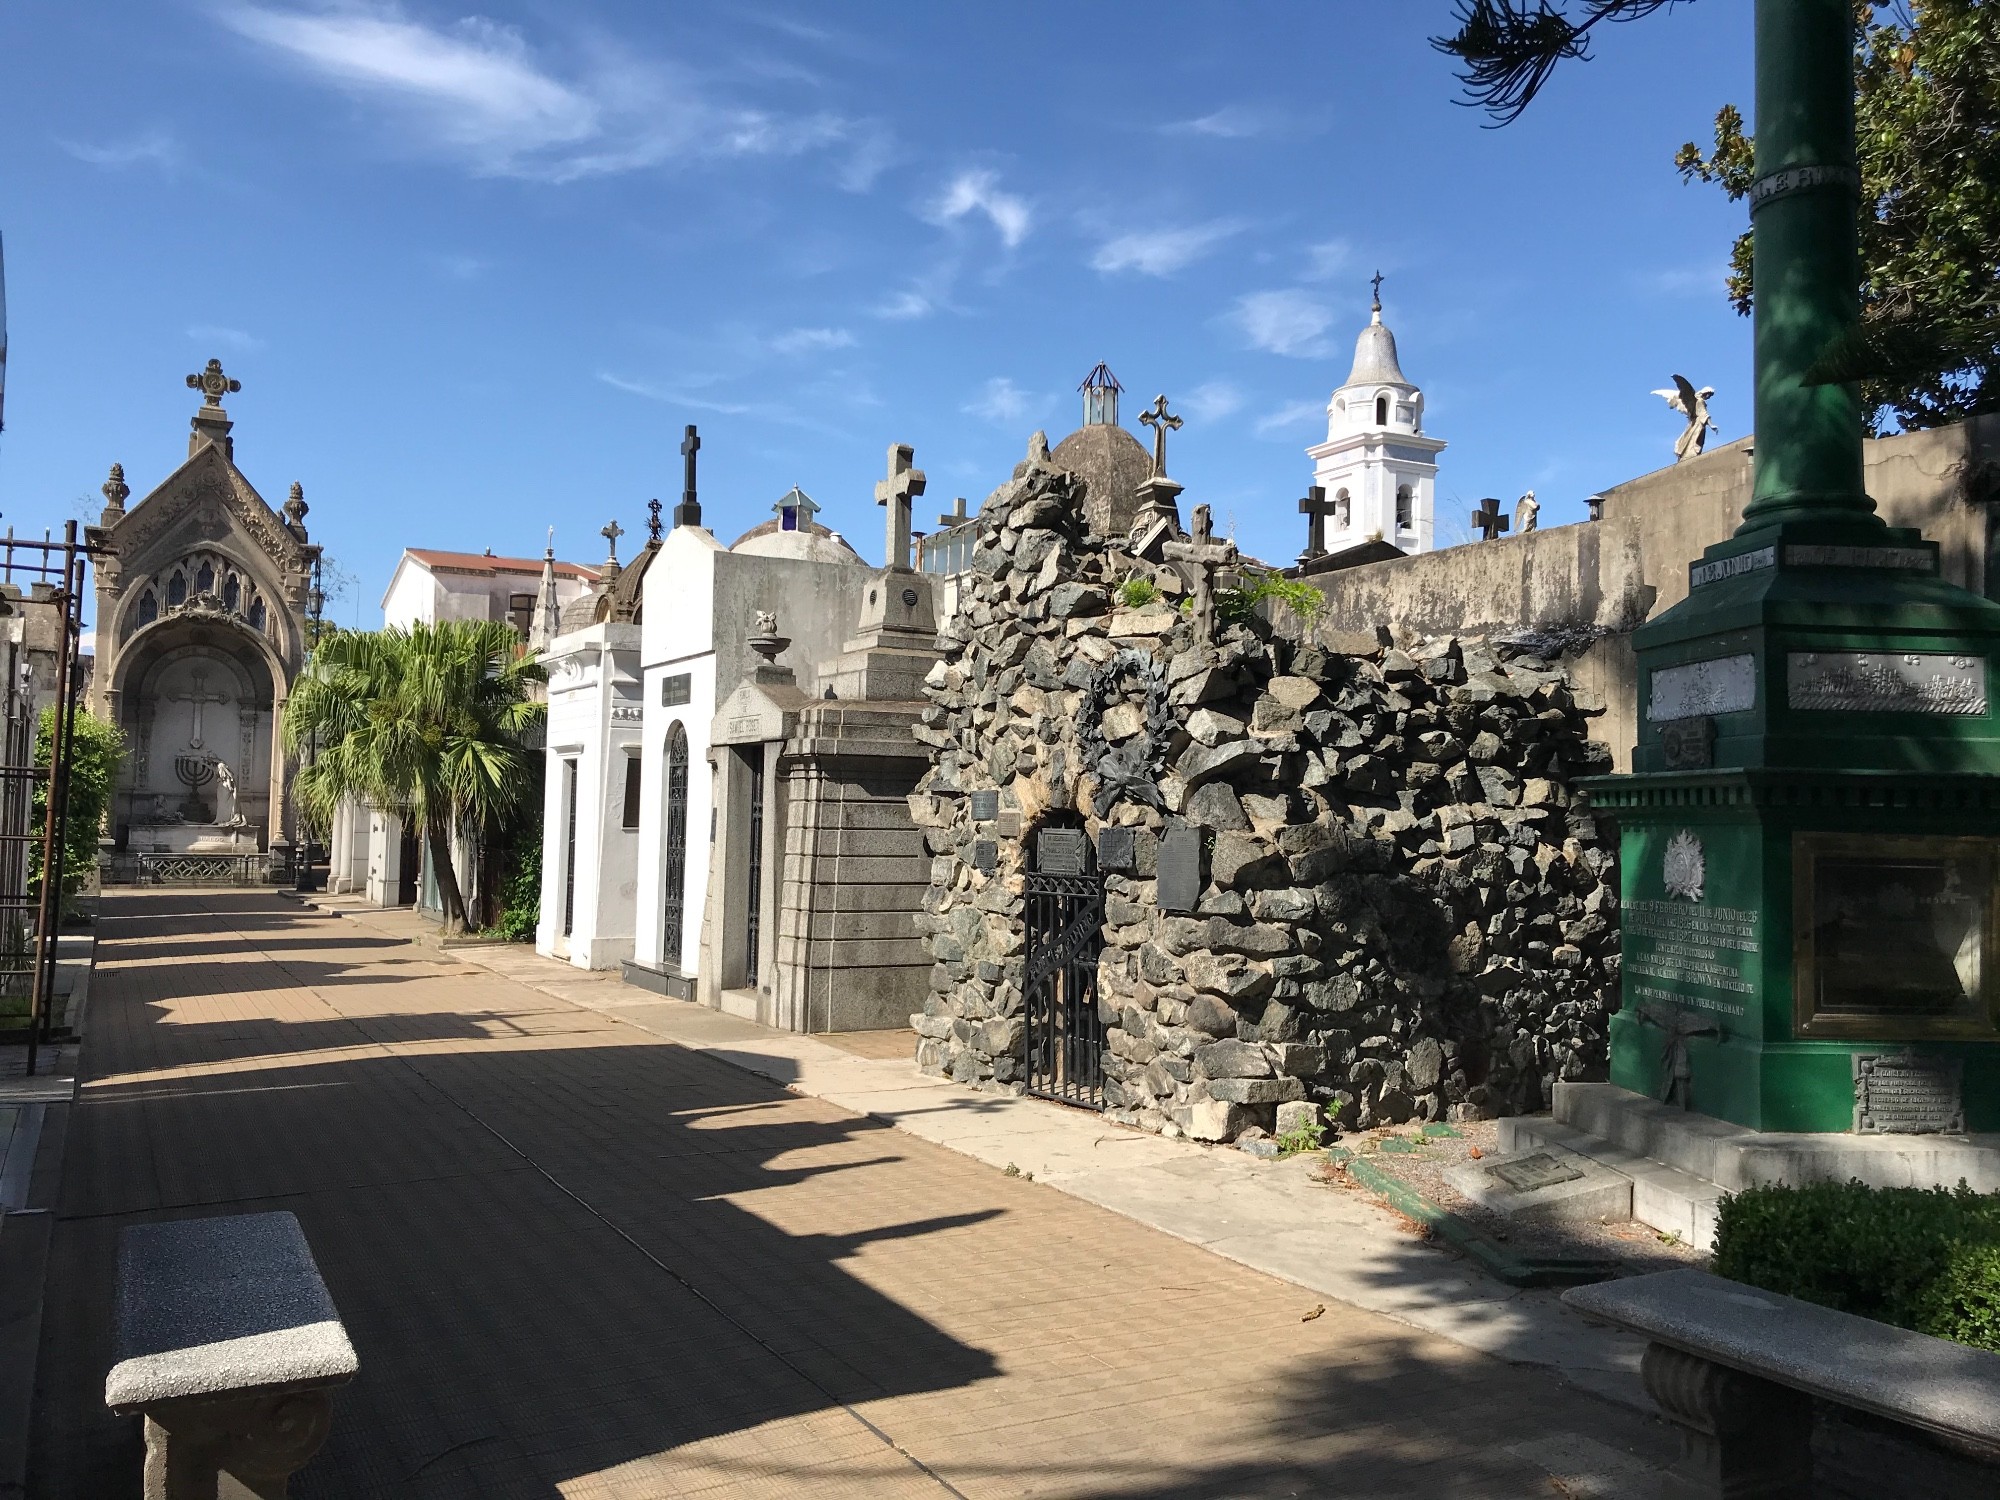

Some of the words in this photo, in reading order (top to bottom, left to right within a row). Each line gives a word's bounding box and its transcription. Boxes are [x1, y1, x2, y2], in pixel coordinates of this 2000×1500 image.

[1655, 901, 1688, 916] FEBRERO
[1714, 908, 1736, 921] JUNIO
[1635, 913, 1656, 925] JULIO
[1699, 922, 1709, 931] LAS
[1064, 912, 1094, 955] GUIDO
[1699, 935, 1709, 945] LAS
[1685, 971, 1712, 987] BROWN
